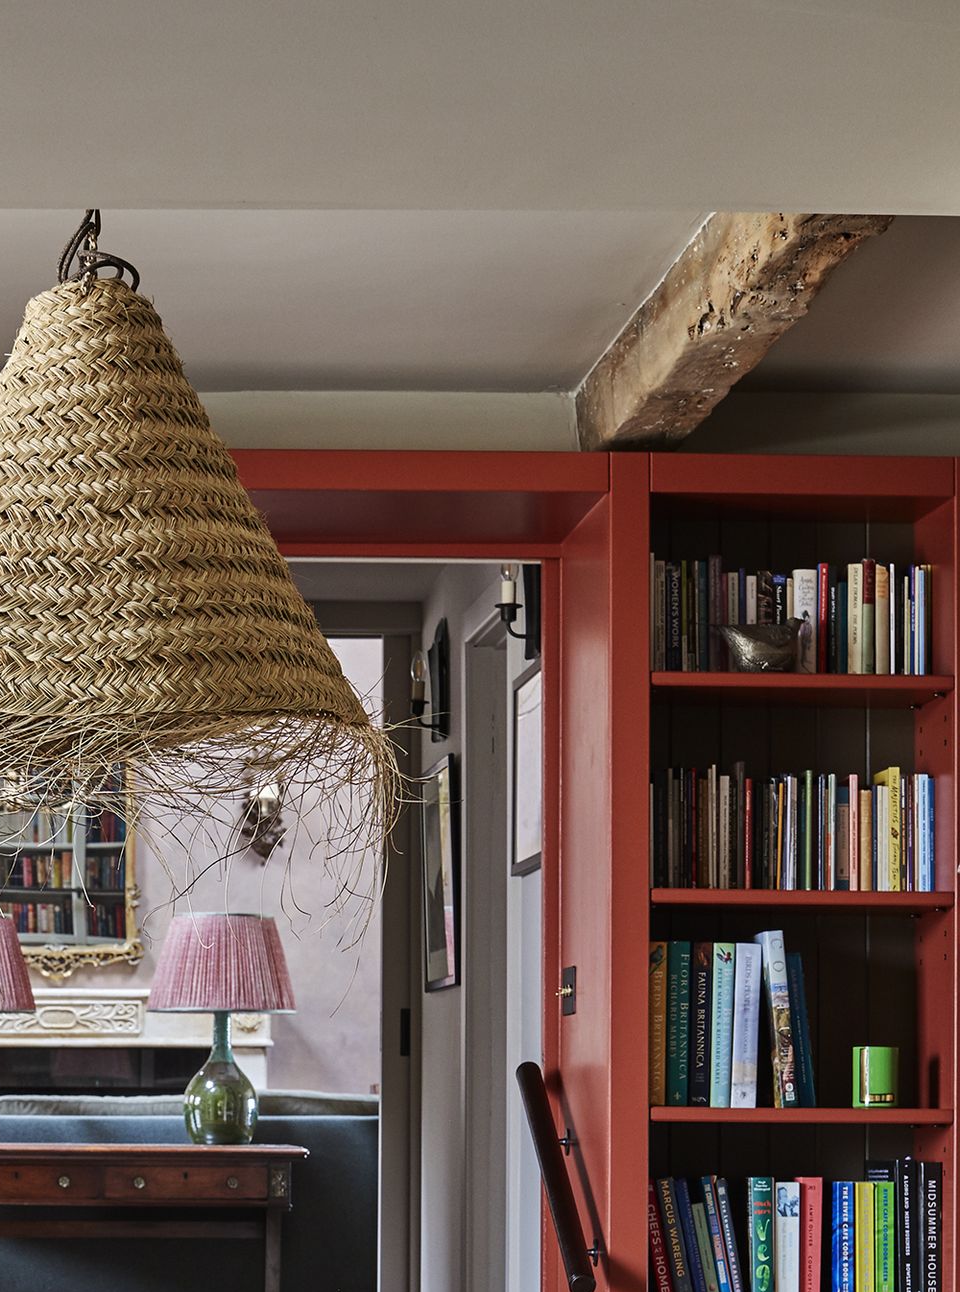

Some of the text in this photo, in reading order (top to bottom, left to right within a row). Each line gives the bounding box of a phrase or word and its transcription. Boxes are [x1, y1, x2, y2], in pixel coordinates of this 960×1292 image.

[672, 618, 680, 648] WORK
[670, 974, 678, 1020] RICHARD
[681, 953, 690, 1080] FLORA BRITANNICA
[697, 972, 706, 1068] FAUNA BRITANNICA
[649, 1204, 662, 1245] CHEFS
[660, 1179, 685, 1277] MARCUS WAREING
[927, 1180, 937, 1249] MIDSUMMER
